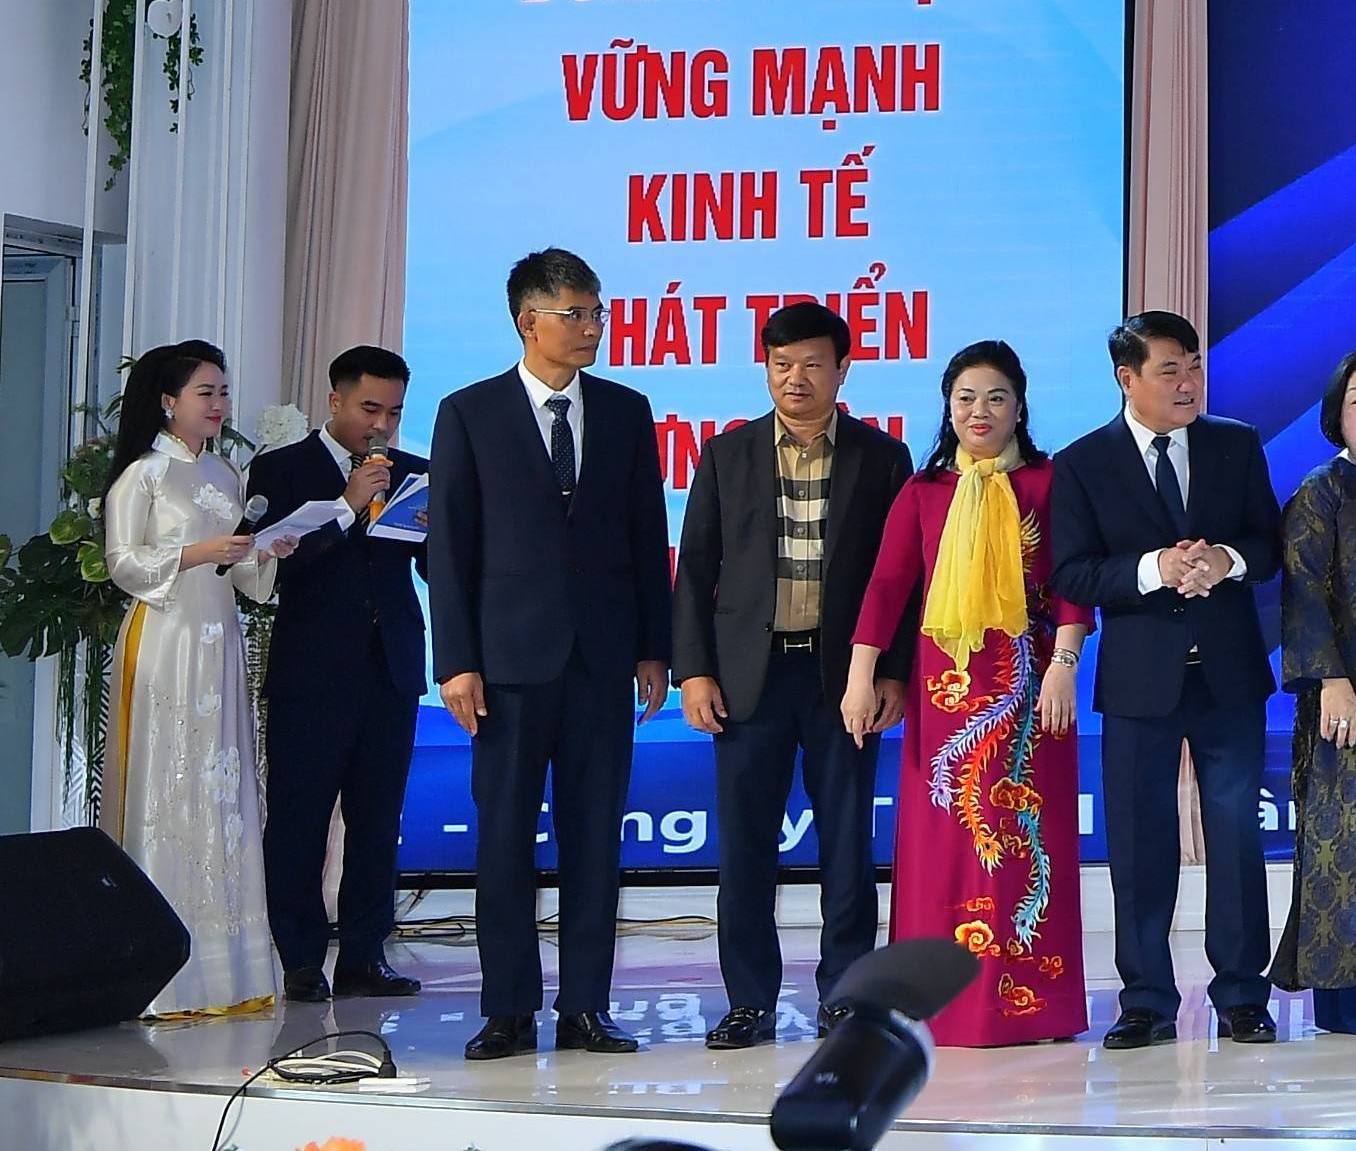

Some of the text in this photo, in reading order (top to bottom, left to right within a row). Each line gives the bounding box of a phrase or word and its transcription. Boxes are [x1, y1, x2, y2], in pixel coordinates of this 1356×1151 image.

[562, 37, 941, 131] VỮNG MẠNH
[627, 145, 876, 243] KINH TẾ
[609, 282, 727, 367] HÁT
